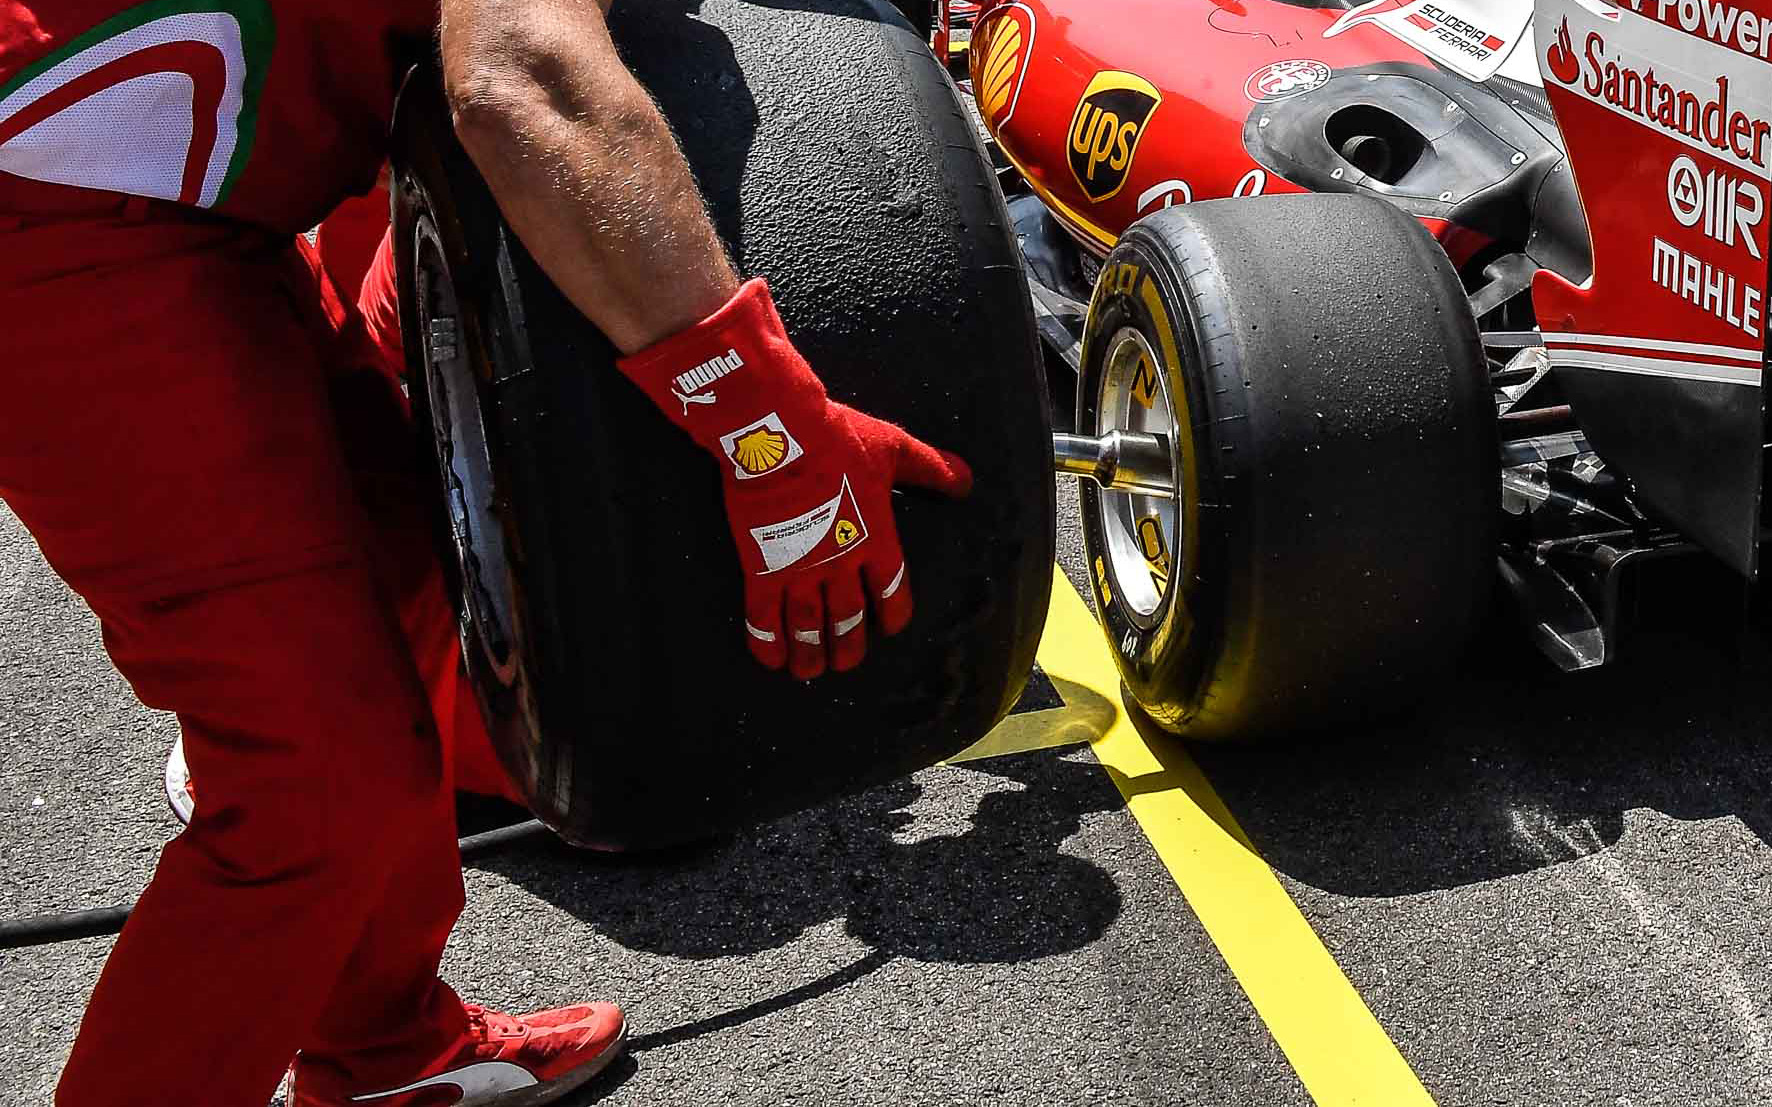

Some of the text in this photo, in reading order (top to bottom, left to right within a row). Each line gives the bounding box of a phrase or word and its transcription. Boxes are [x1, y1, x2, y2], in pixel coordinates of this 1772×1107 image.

[1418, 3, 1487, 42] SCUDERIA
[1428, 27, 1493, 62] FERRARI
[1582, 29, 1772, 168] Santander
[1072, 101, 1138, 181] ups
[1652, 235, 1762, 339] MAHLE
[676, 348, 745, 394] PUMA
